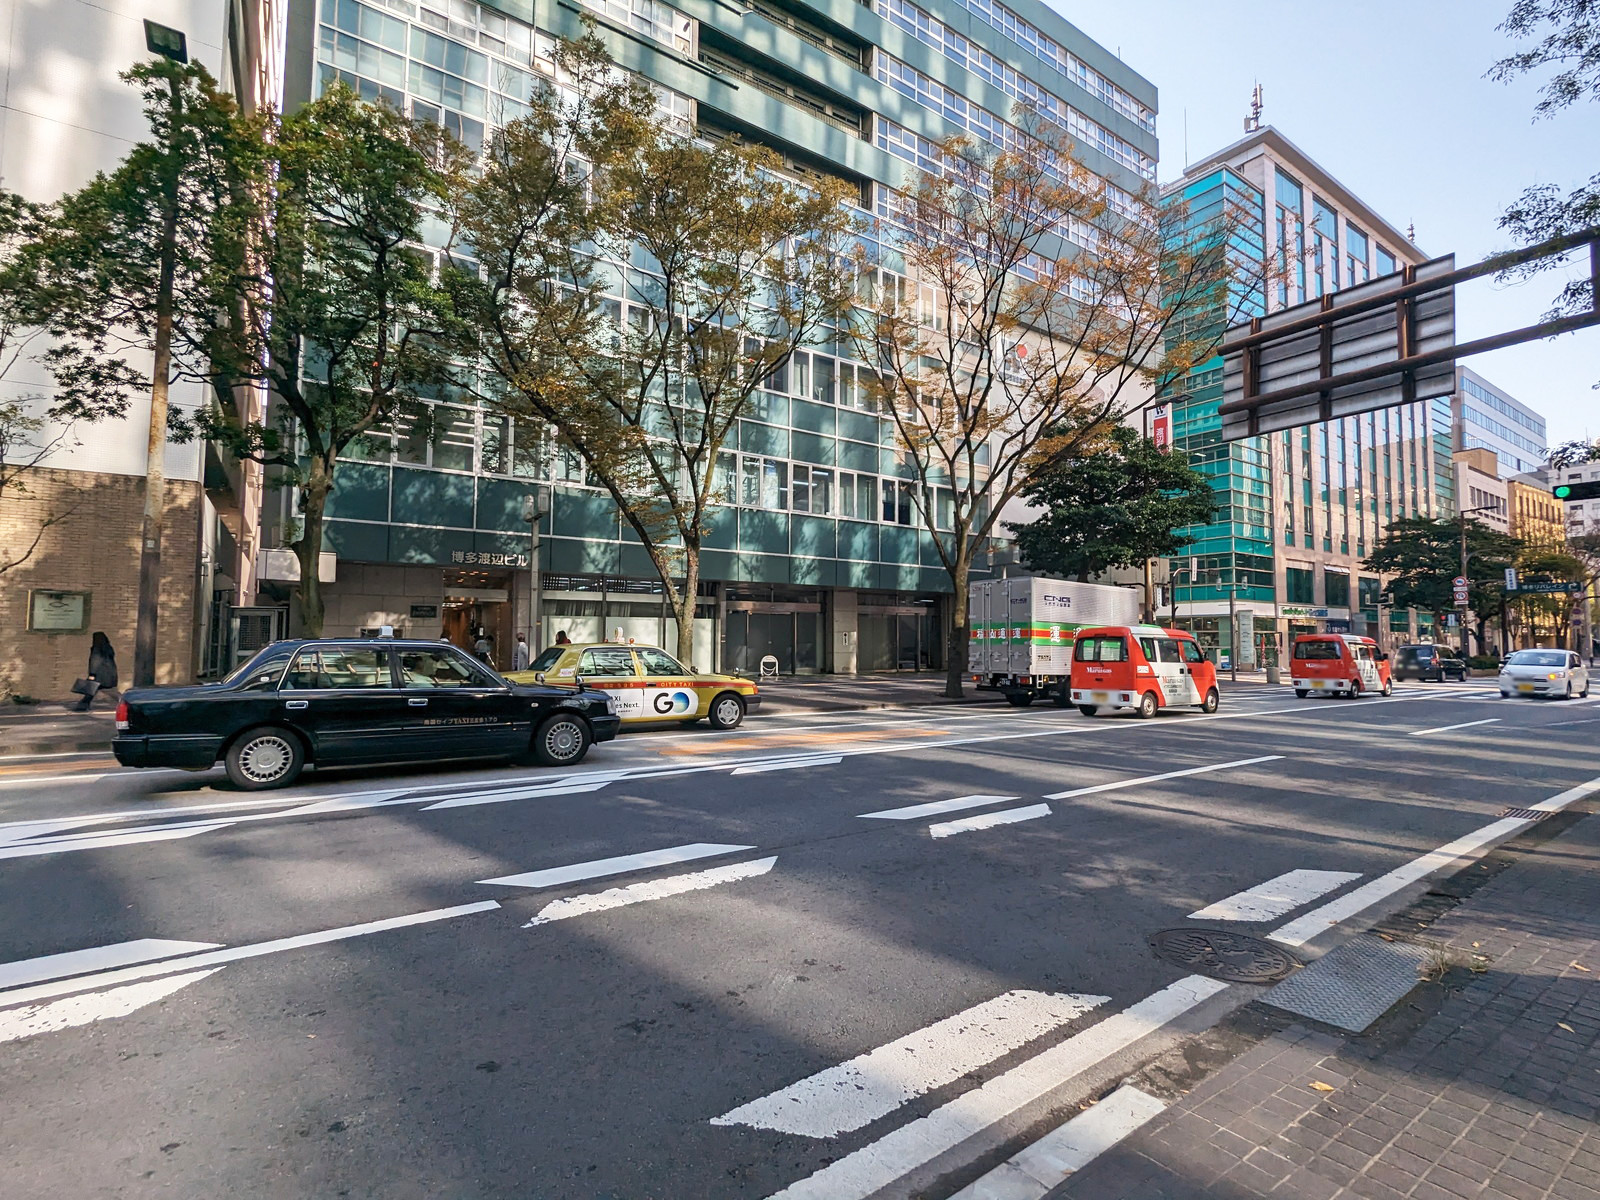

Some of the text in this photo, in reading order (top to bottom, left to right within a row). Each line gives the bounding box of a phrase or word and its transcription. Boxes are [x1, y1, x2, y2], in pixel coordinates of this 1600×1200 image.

[451, 550, 529, 567] 博多渡辺ビル
[1043, 595, 1071, 603] CNG
[653, 692, 690, 714] GO
